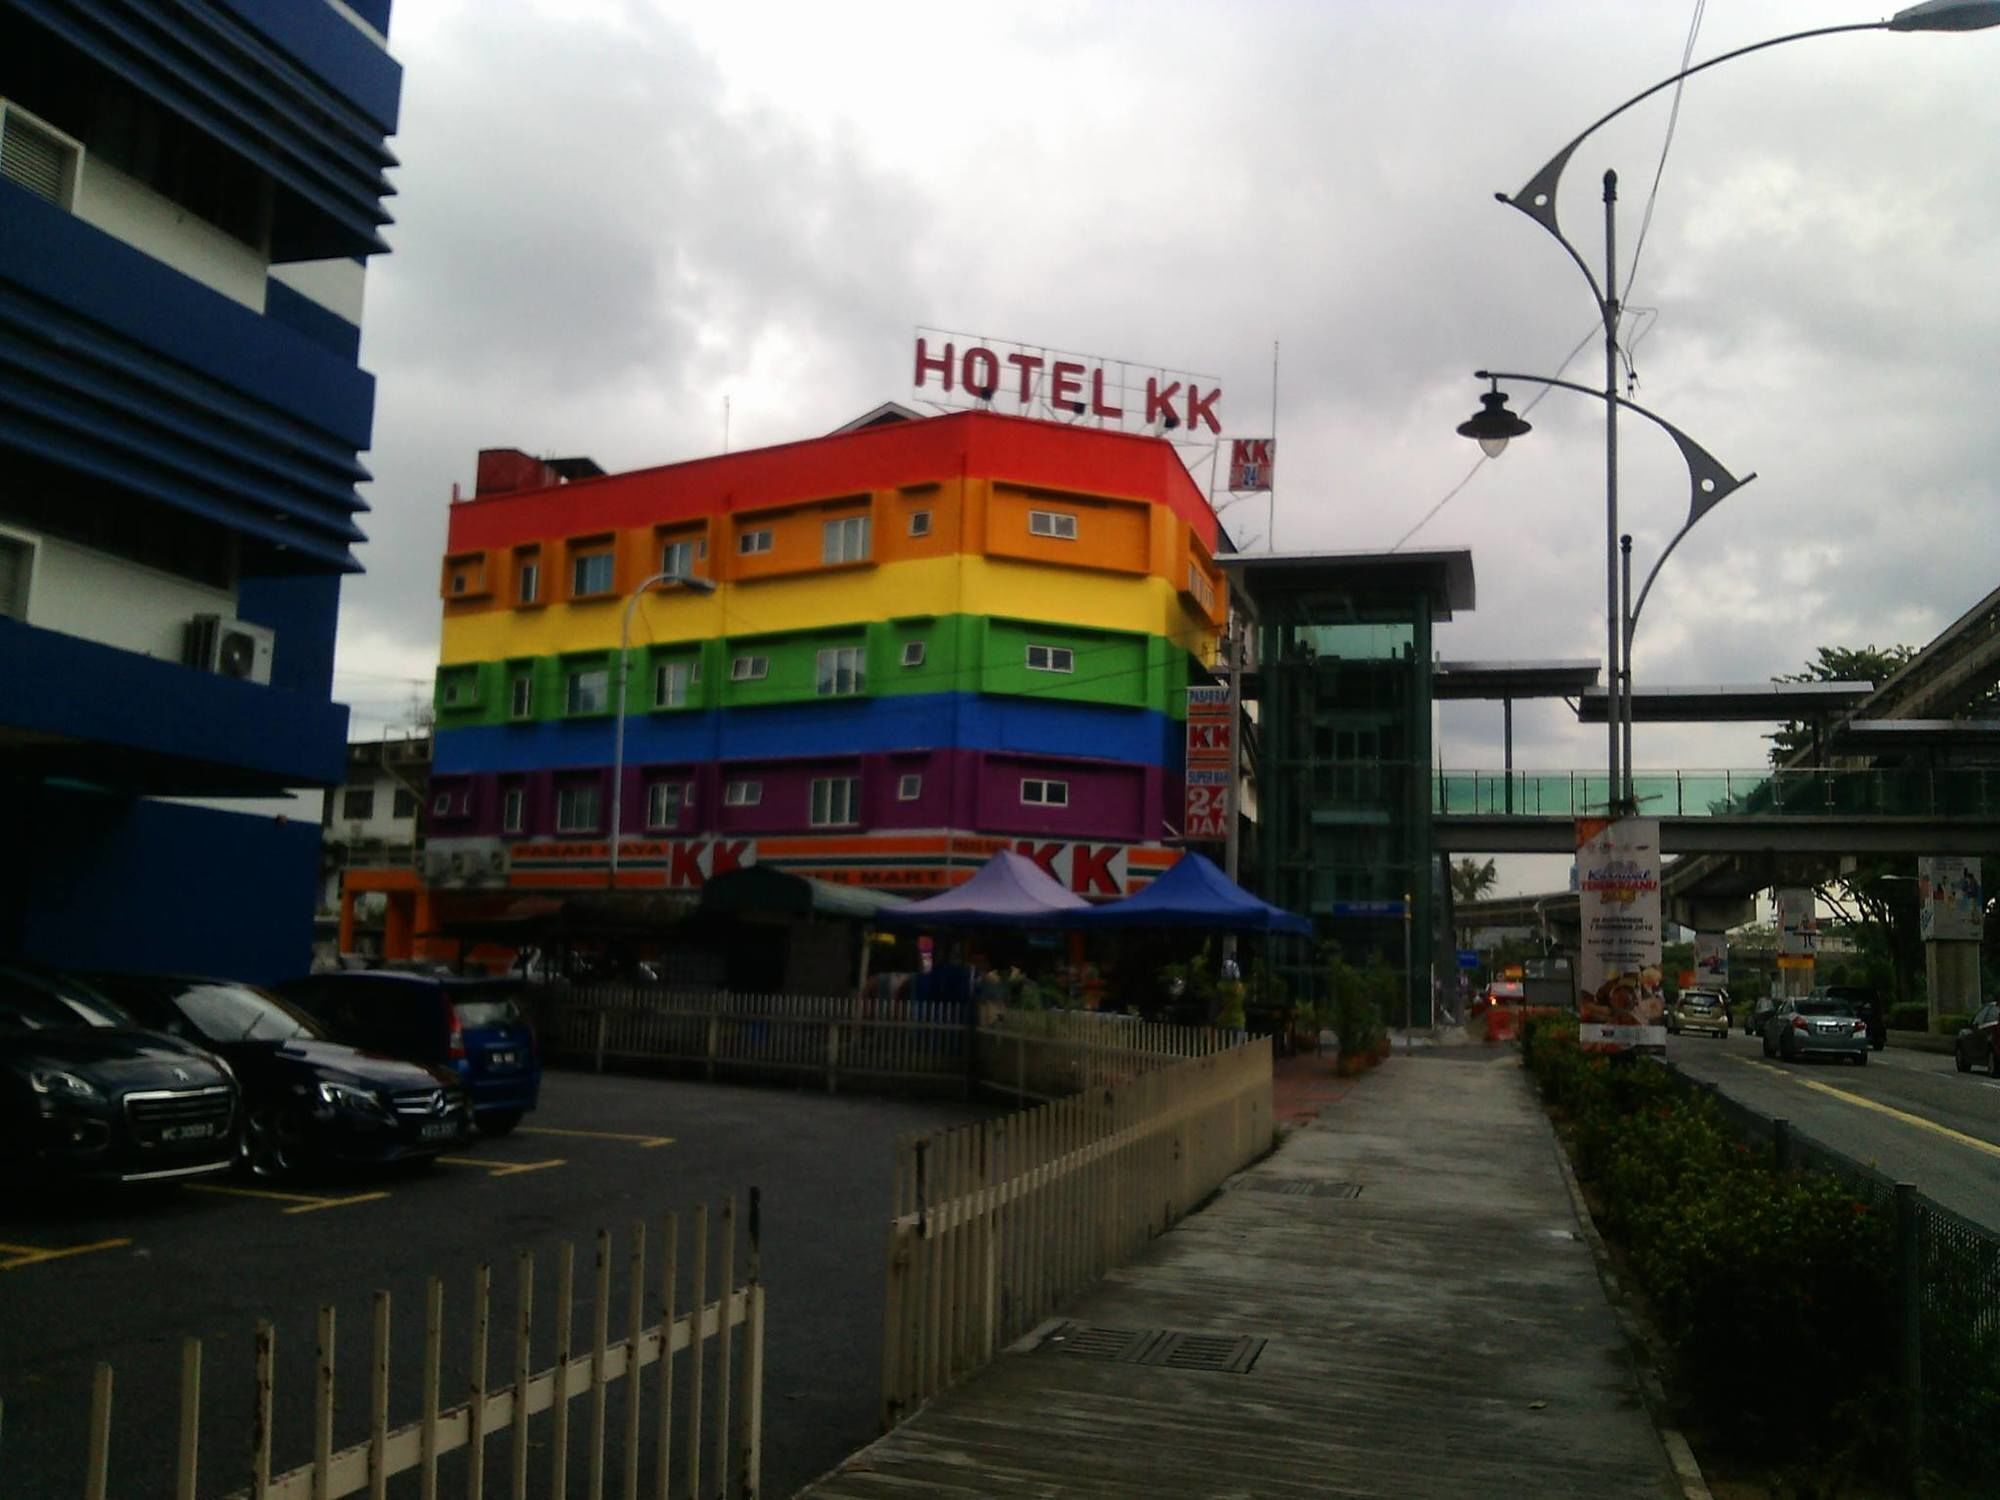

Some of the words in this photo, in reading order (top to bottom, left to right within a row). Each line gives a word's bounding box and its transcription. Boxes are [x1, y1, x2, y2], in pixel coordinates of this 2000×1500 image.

[915, 338, 1123, 419] HOTEL
[1145, 377, 1222, 435] KK
[1234, 439, 1269, 463] KK
[1190, 726, 1231, 748] KK
[1188, 787, 1229, 816] 24
[514, 844, 592, 858] PASAR
[671, 840, 750, 888] KK
[861, 870, 941, 884] MART
[1016, 841, 1122, 894] KK
